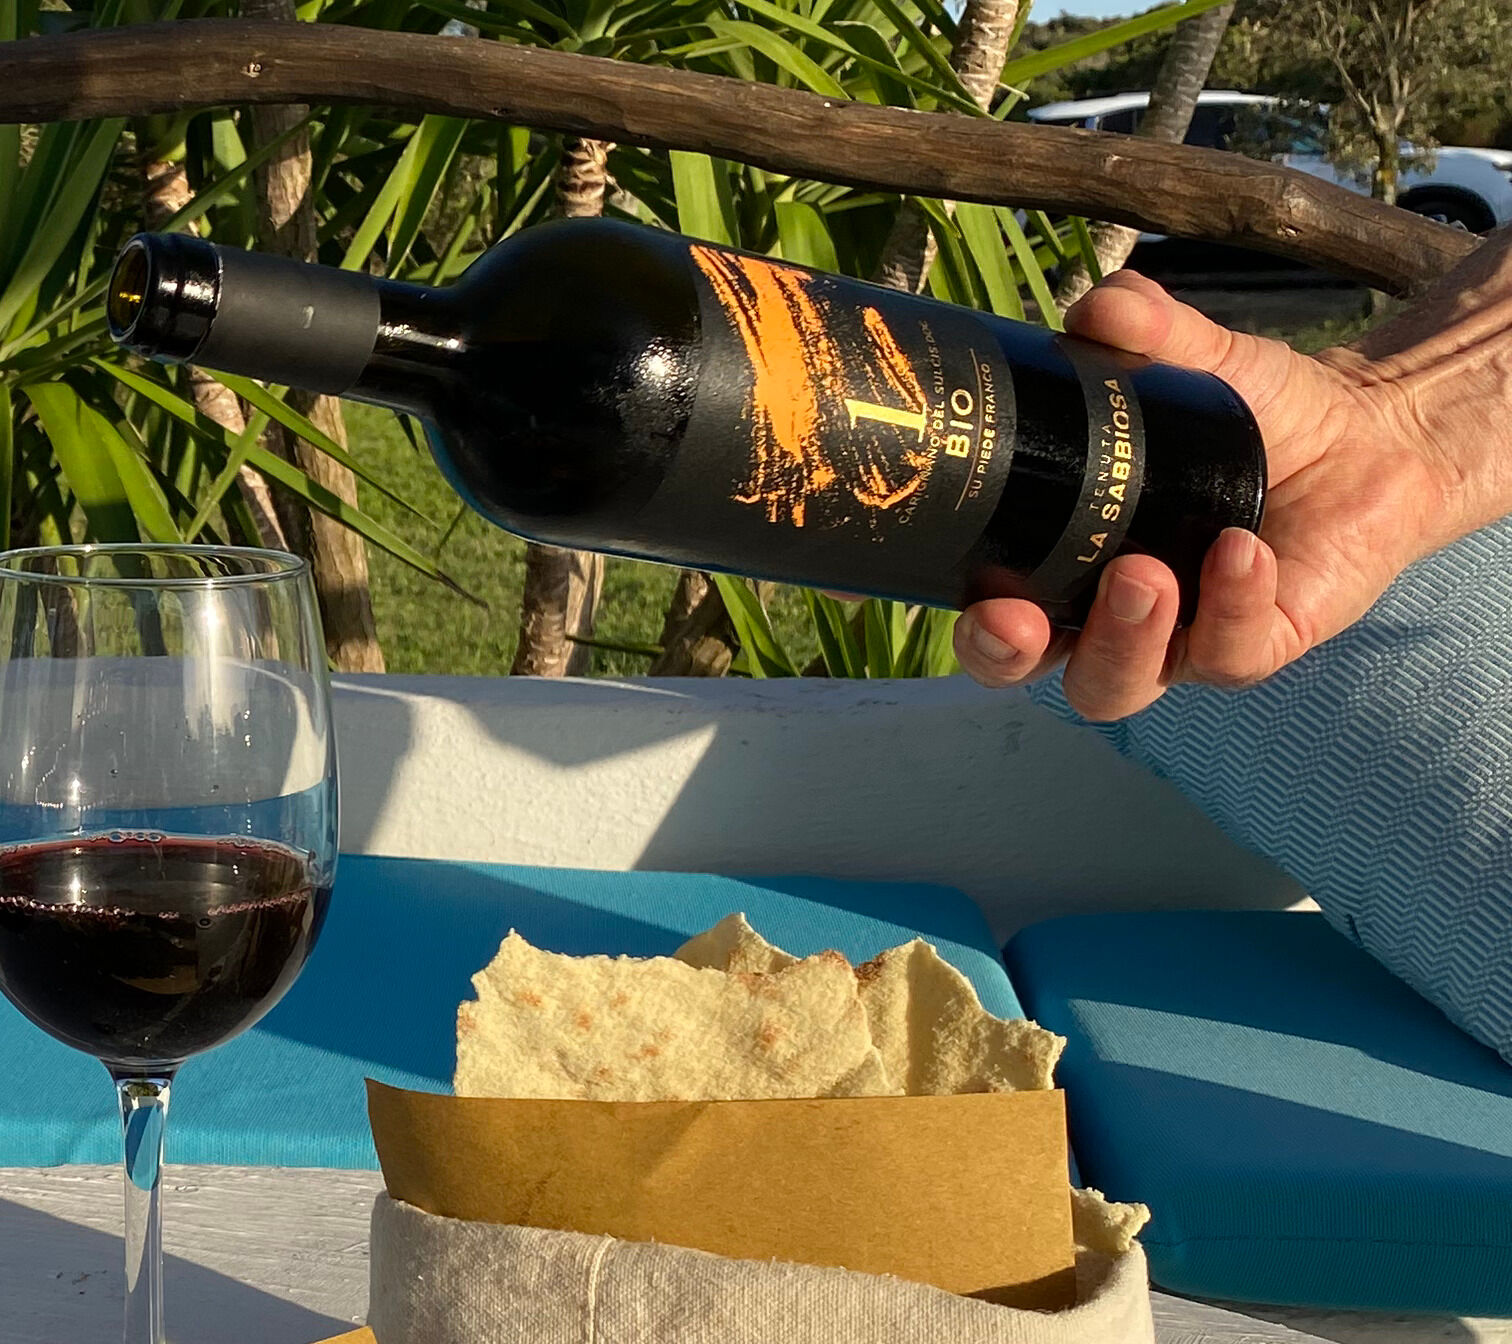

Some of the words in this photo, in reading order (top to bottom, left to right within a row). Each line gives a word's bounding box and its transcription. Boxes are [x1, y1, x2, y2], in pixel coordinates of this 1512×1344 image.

[929, 346, 944, 395] SULCIS
[981, 364, 996, 424] FRANCO
[843, 398, 927, 443] 1
[932, 401, 945, 430] DEL
[944, 388, 975, 459] BIO
[977, 429, 996, 474] PIEDE
[1077, 531, 1109, 563] LA
[1101, 378, 1133, 522] SABBIOSA
[1088, 424, 1113, 510] TENUTA
[898, 436, 941, 524] CARIGNANO
[969, 480, 983, 499] SU
